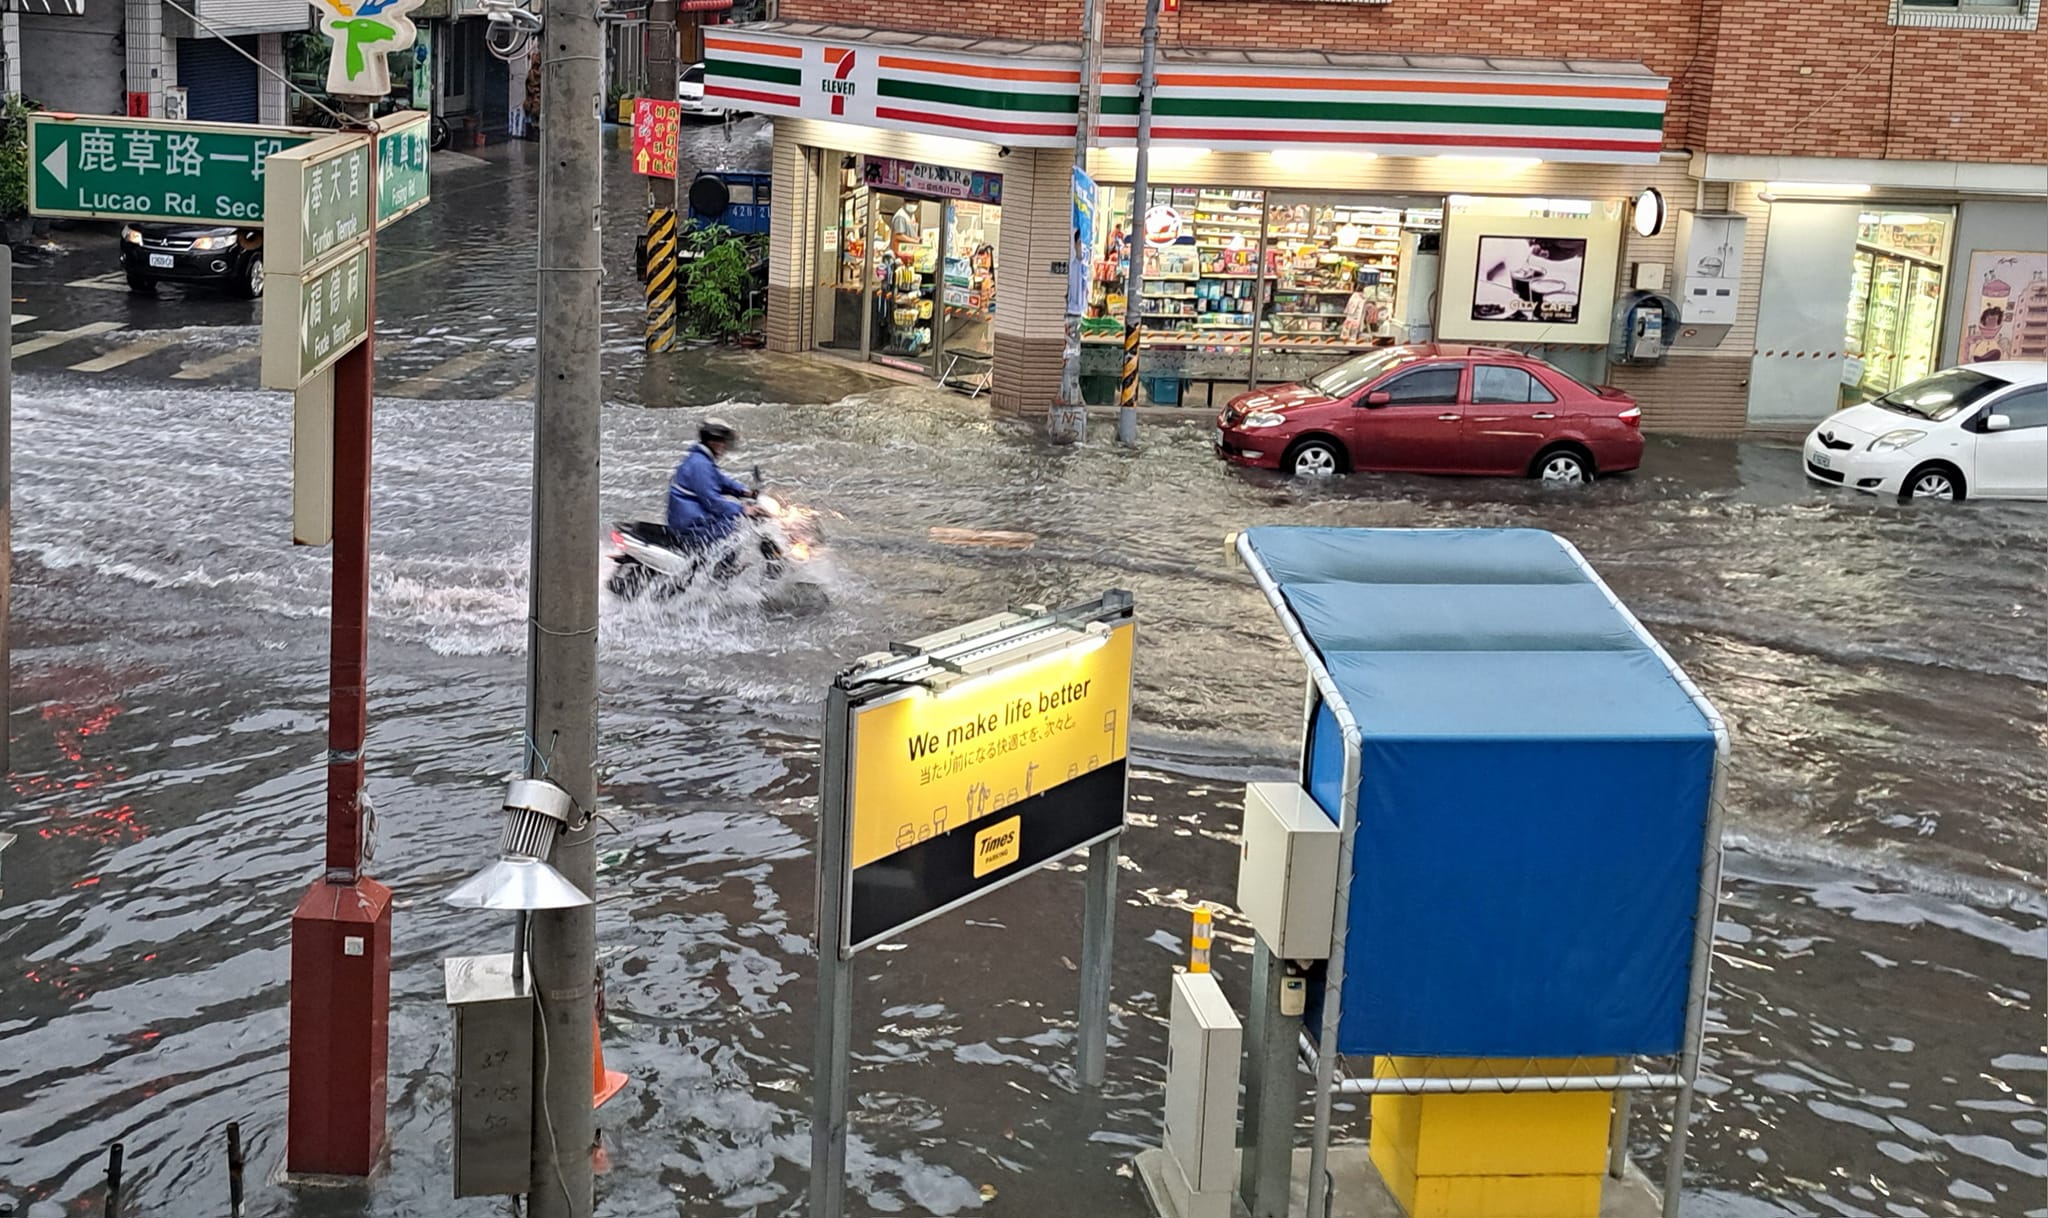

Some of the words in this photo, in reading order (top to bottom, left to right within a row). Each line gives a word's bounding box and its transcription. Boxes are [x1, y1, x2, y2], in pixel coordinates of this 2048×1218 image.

[78, 128, 282, 181] 鹿草路一段
[385, 128, 422, 182] 復興路
[79, 188, 151, 211] Lucao
[165, 193, 201, 214] Rd.
[311, 152, 360, 214] 奉天宮
[336, 213, 357, 240] Temple
[314, 332, 330, 359] Fude
[332, 315, 352, 346] Temple
[908, 732, 939, 762] We
[947, 713, 998, 748] make
[1004, 698, 1032, 726] life
[1039, 678, 1091, 713] better
[979, 831, 1015, 857] Times
